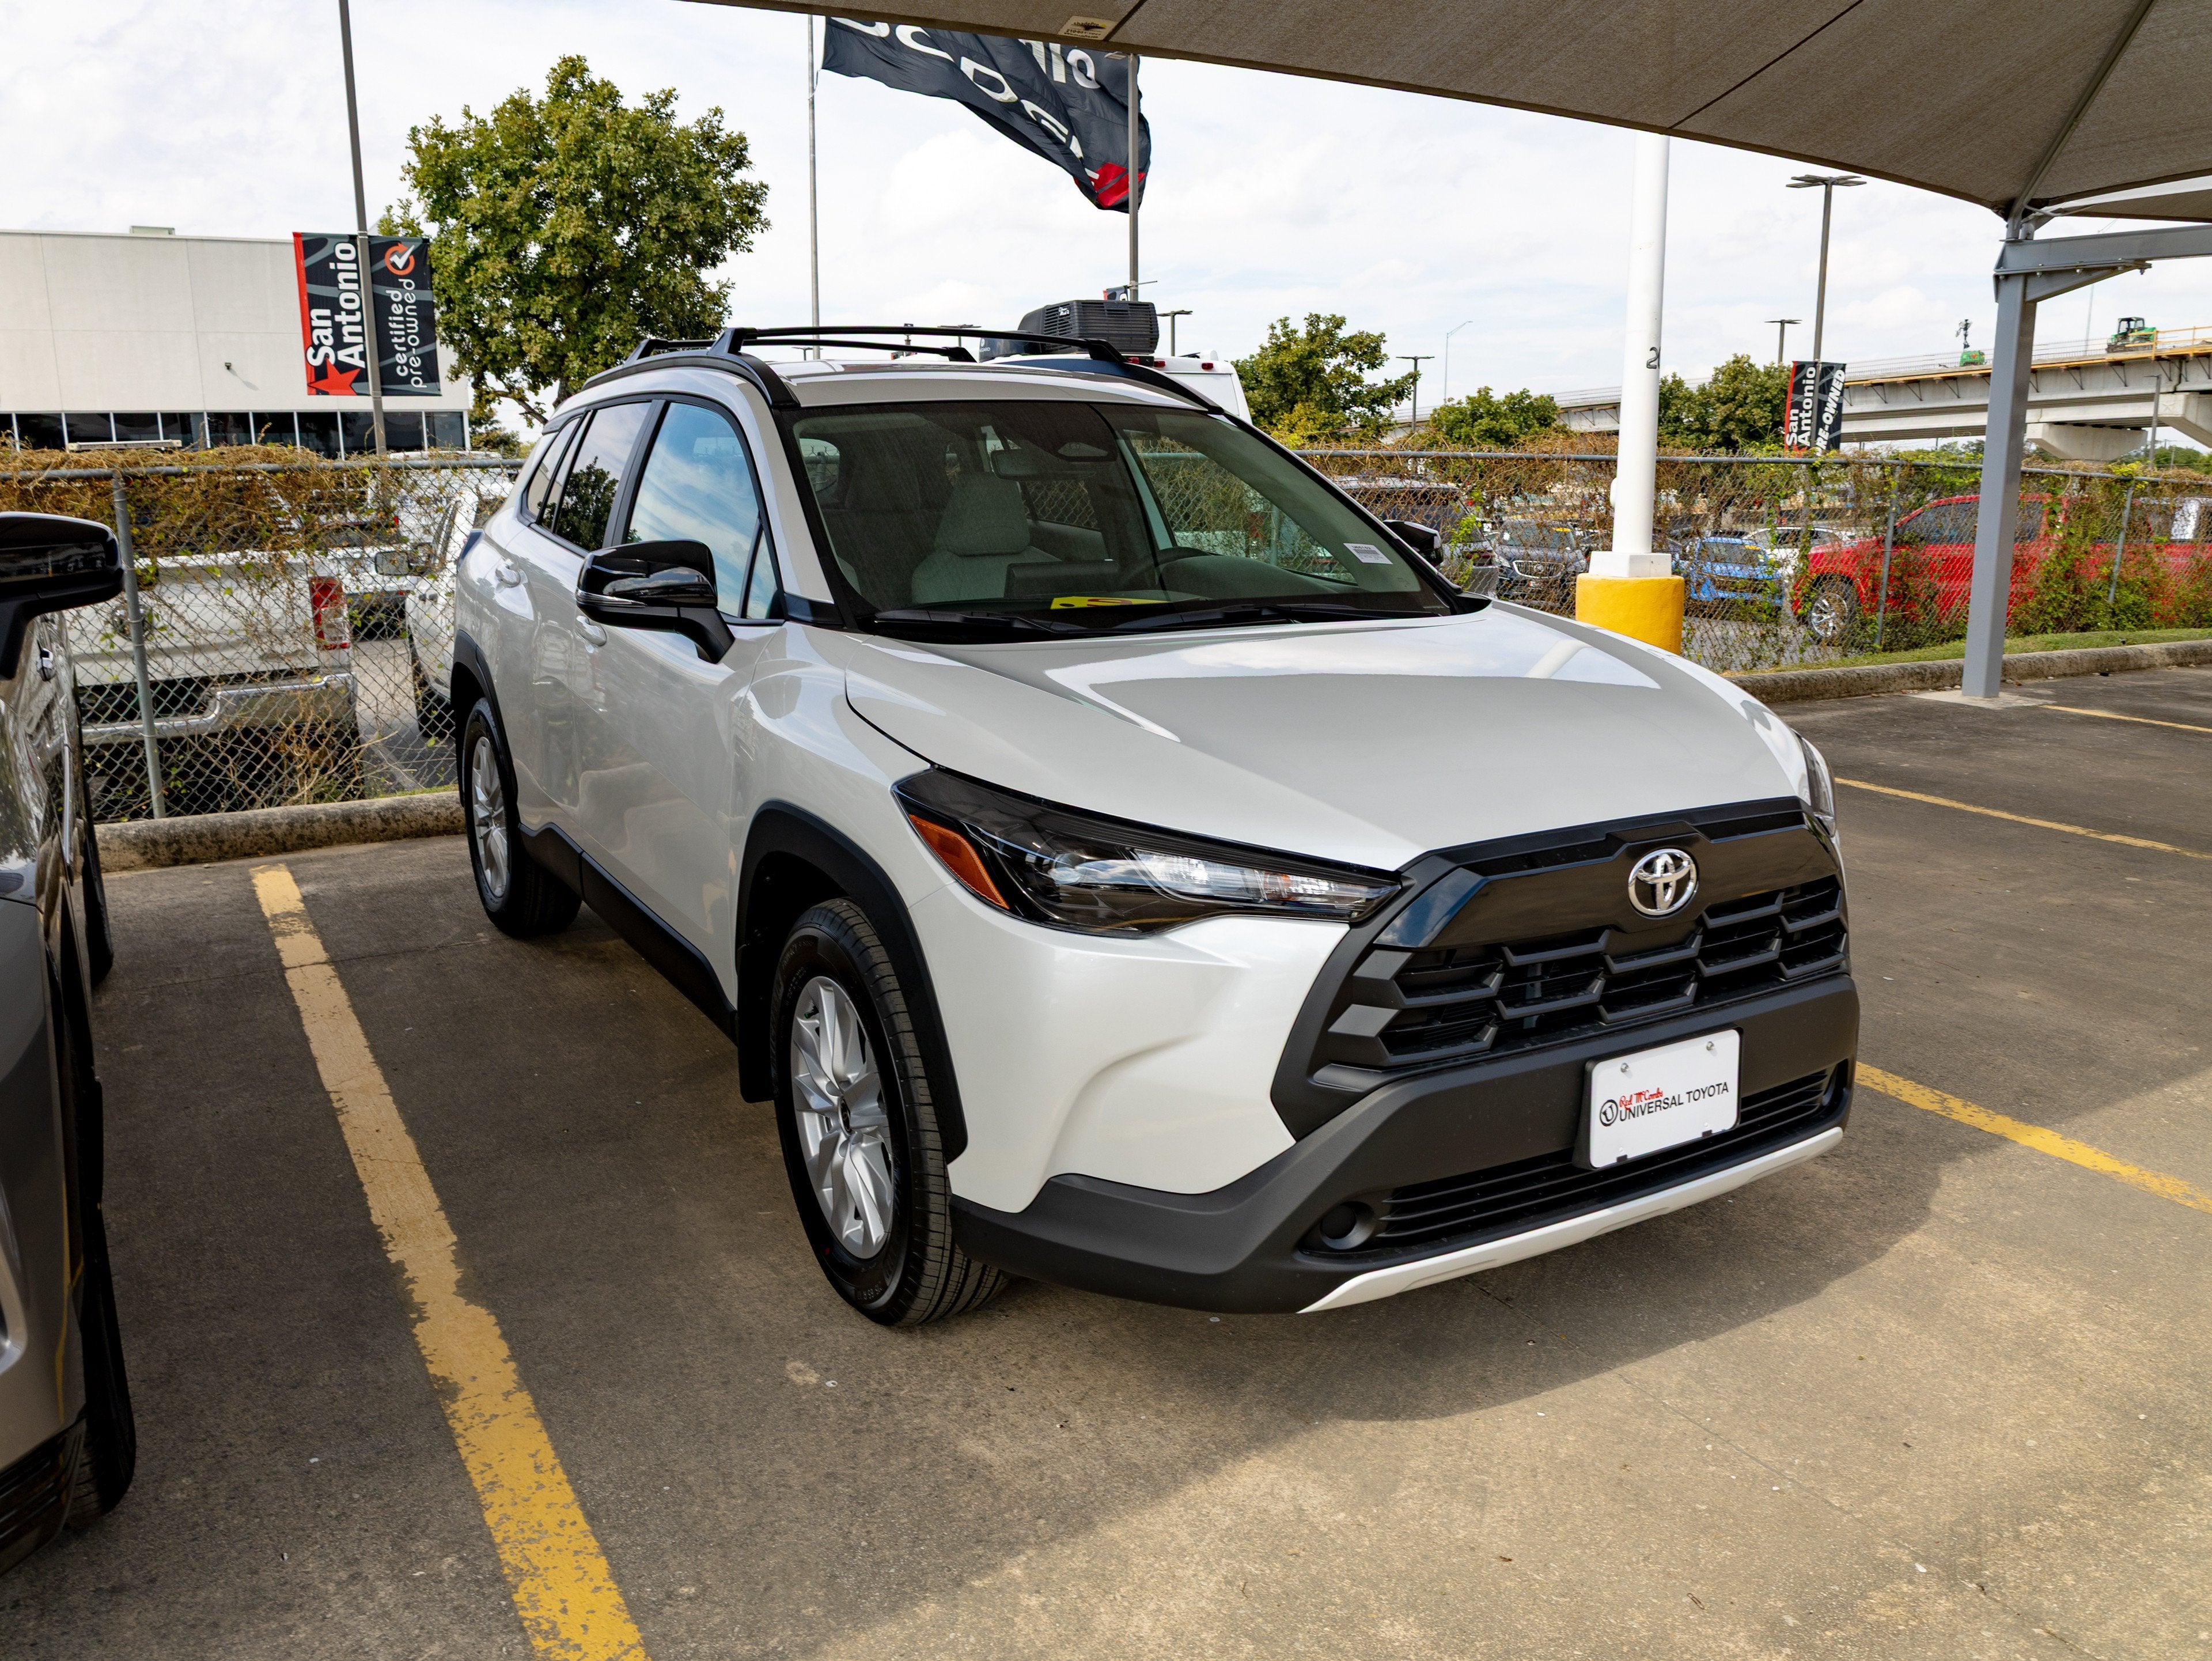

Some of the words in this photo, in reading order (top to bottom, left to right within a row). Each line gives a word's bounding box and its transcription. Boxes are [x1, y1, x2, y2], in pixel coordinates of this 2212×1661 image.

[306, 308, 336, 367] San
[329, 241, 366, 369] Antonio
[385, 290, 408, 377] certified
[399, 278, 427, 388] pre-owned
[1786, 408, 1800, 447] San
[1797, 366, 1816, 447] Antonio
[1619, 1095, 1633, 1110] Red
[1634, 1087, 1663, 1103] McCombs
[1619, 1094, 1683, 1122] UNIVERSAL
[1686, 1081, 1729, 1103] TOYOTA
